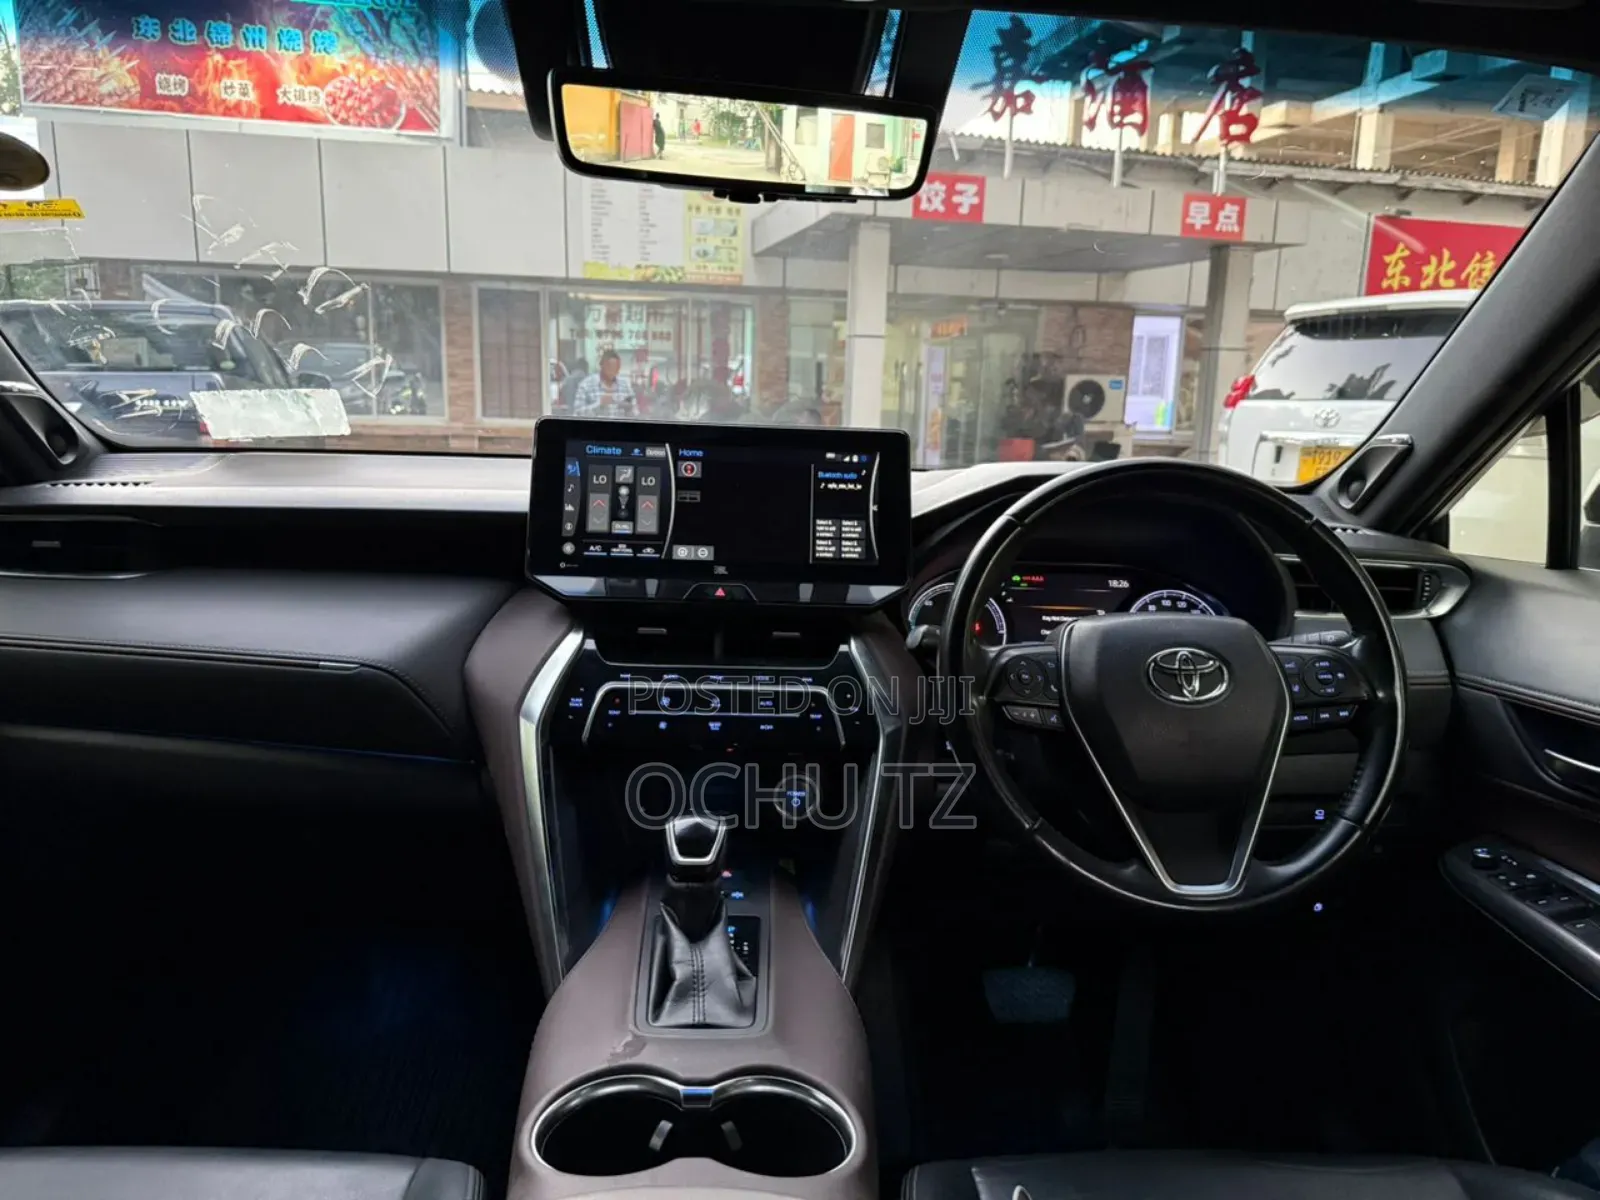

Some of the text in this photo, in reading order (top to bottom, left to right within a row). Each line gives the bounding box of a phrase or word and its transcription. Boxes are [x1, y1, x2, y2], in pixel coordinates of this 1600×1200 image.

[918, 179, 981, 216] 饺子
[1184, 200, 1241, 233] 早点
[585, 445, 622, 457] Climate
[678, 449, 704, 457] Home
[592, 475, 607, 484] LO
[641, 476, 656, 486] LO
[1108, 579, 1130, 588] 18:26
